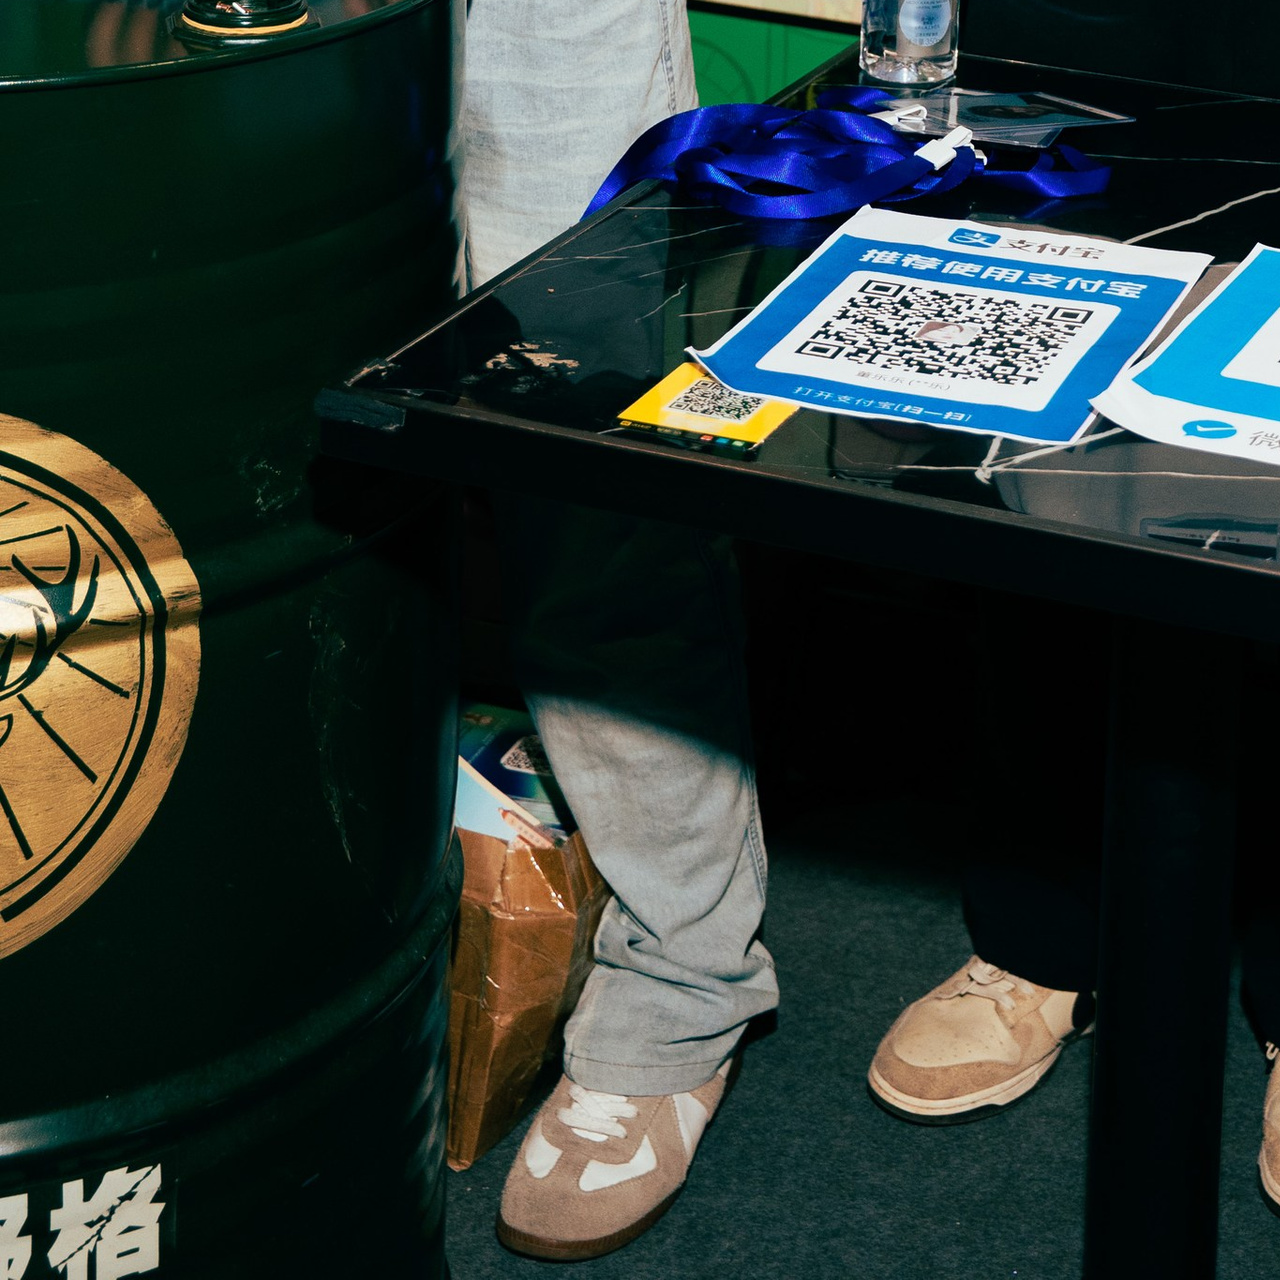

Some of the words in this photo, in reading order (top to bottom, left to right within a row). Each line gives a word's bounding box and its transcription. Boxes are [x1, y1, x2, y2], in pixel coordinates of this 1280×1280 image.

[1000, 237, 1106, 260] 支付宝
[859, 249, 1149, 300] 推荐使用支付宝
